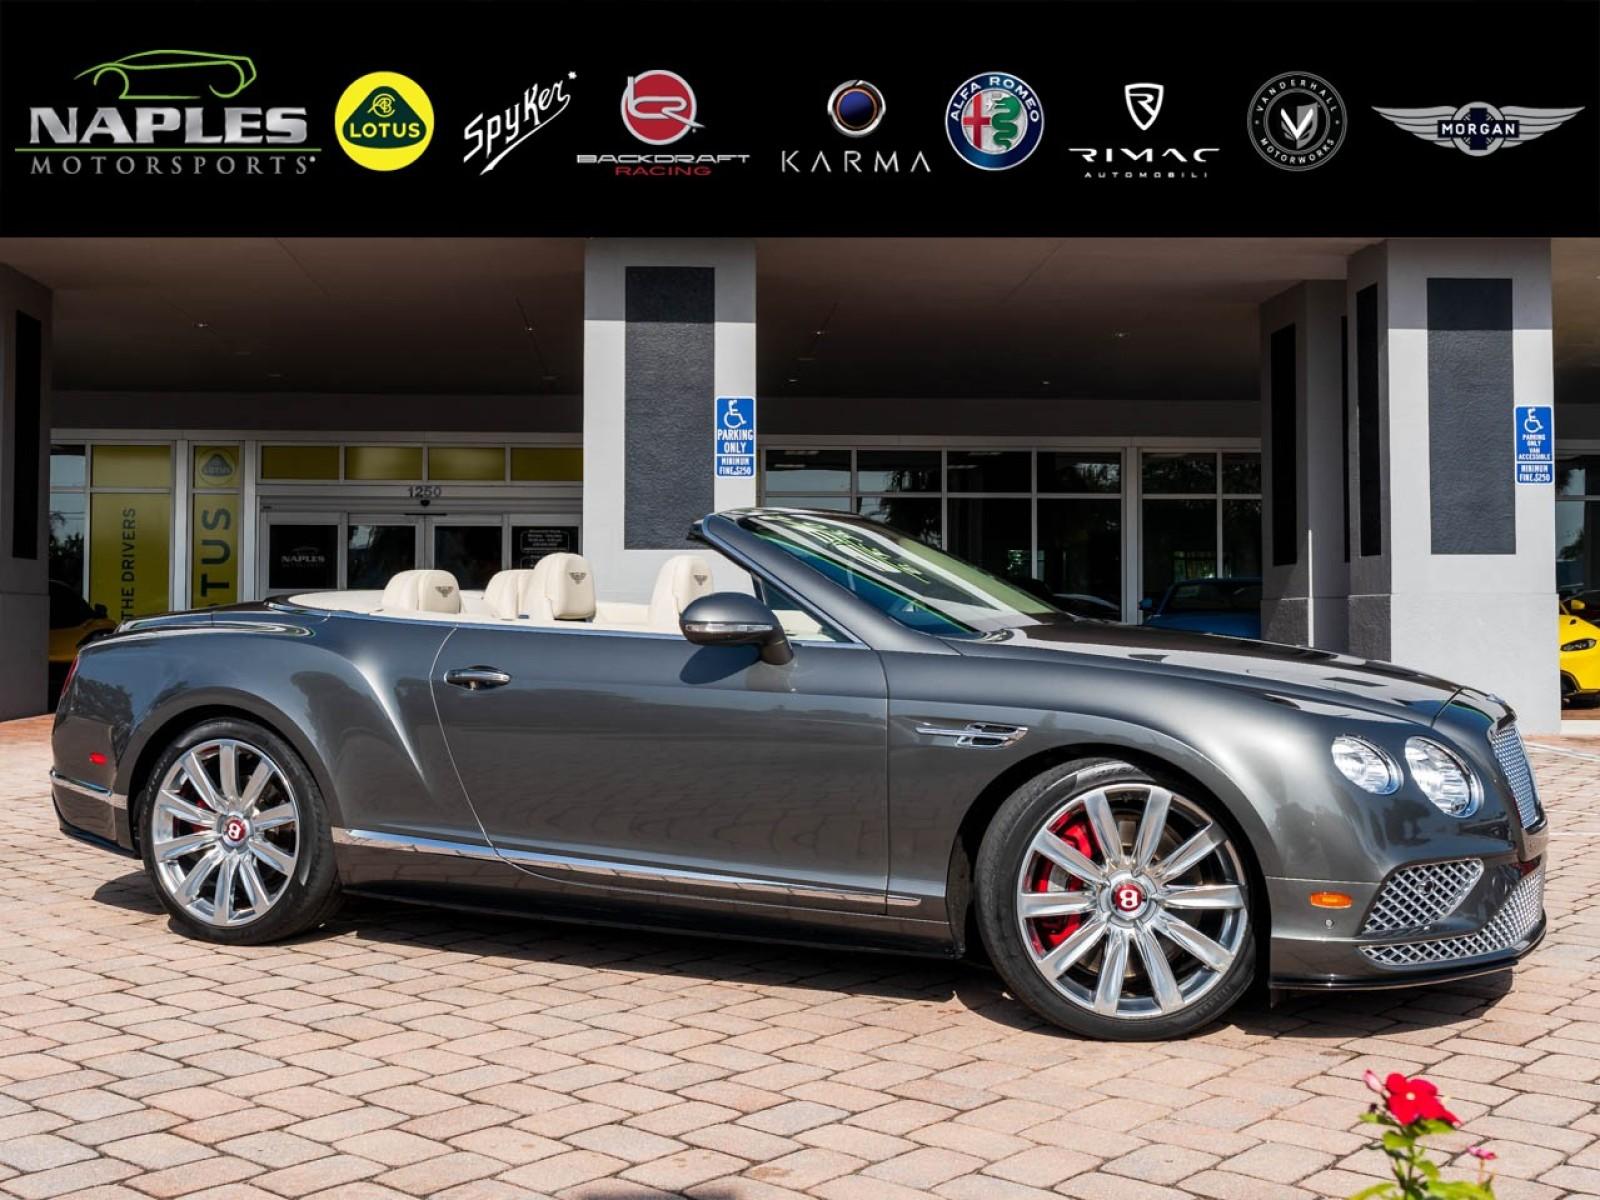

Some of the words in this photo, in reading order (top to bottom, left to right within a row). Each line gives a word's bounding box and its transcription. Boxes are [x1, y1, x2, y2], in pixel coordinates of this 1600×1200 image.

[717, 429, 754, 441] PARKING
[1522, 433, 1546, 441] PARKING
[723, 441, 747, 454] ONLY
[721, 457, 750, 466] MINIMUM
[1518, 453, 1551, 461] ACCESSIBLE
[1520, 464, 1549, 473] MINIMUM
[409, 486, 441, 497] 1250
[121, 508, 136, 582] DRIVERS
[201, 507, 231, 606] TUS
[121, 587, 134, 621] THE
